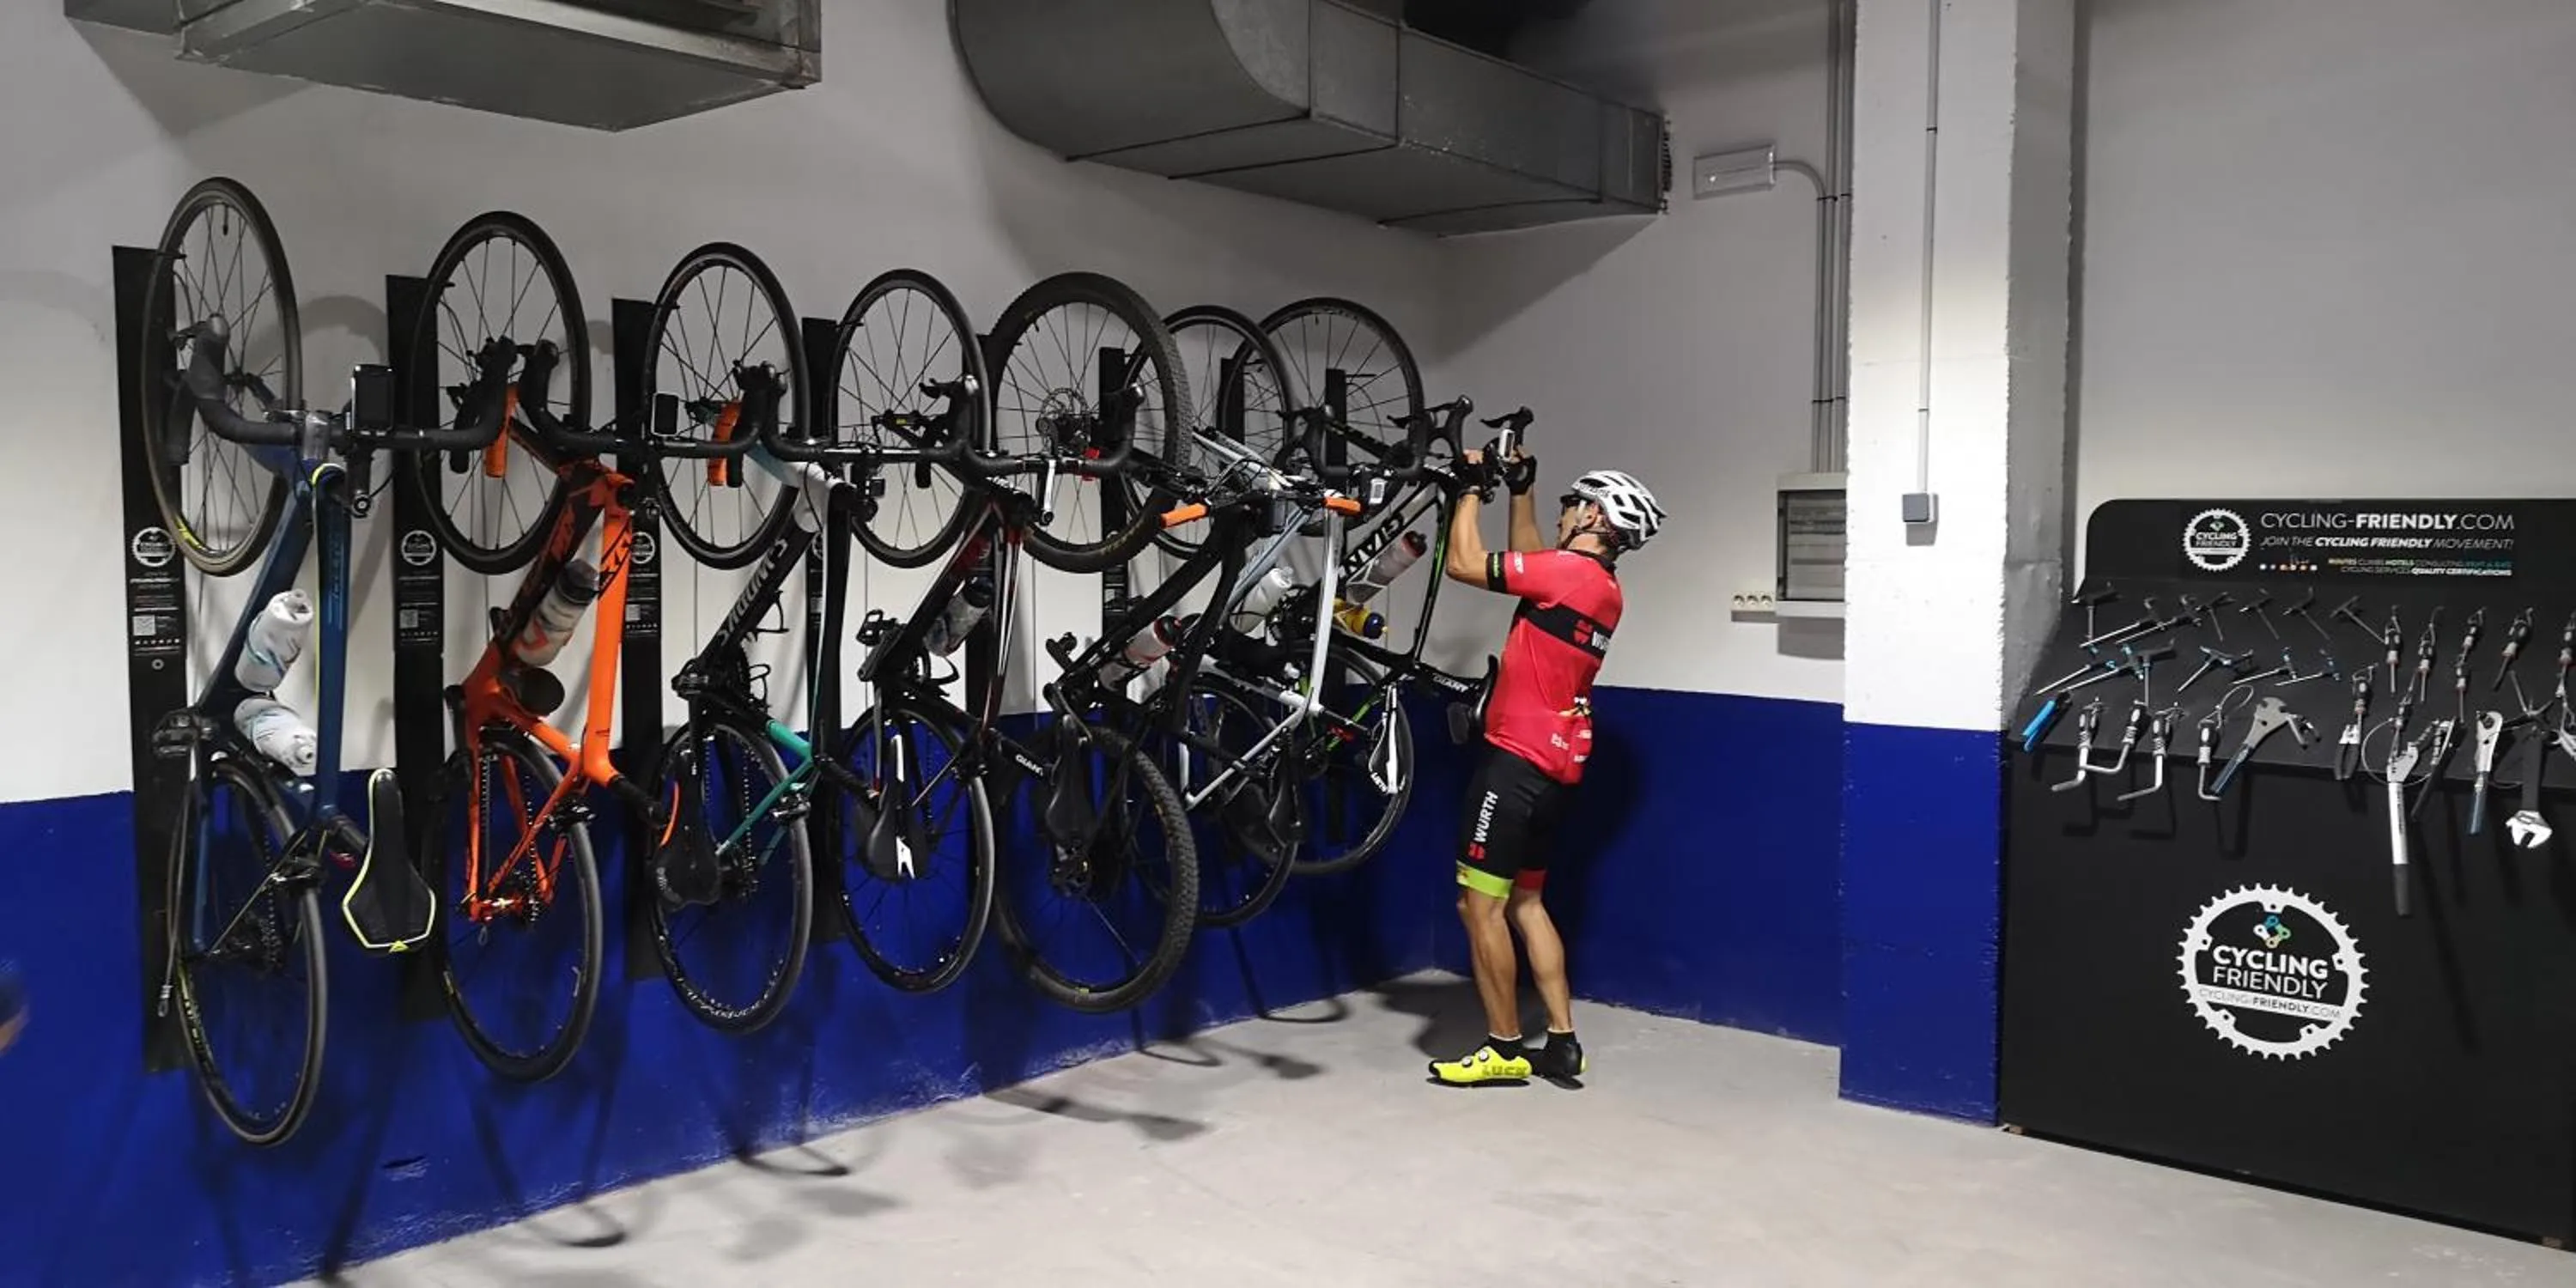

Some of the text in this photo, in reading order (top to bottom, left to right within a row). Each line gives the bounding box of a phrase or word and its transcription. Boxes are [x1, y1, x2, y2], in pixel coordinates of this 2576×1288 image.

[2260, 513, 2514, 530] CYCLING-FRIENDLY.COM
[2260, 536, 2289, 548] JOIN
[2292, 536, 2314, 547] THE
[2314, 536, 2370, 548] CYCLING
[2370, 537, 2432, 550] FRIENDLY
[2213, 945, 2329, 980] CYCLING
[2213, 966, 2329, 999] FRIENDLY
